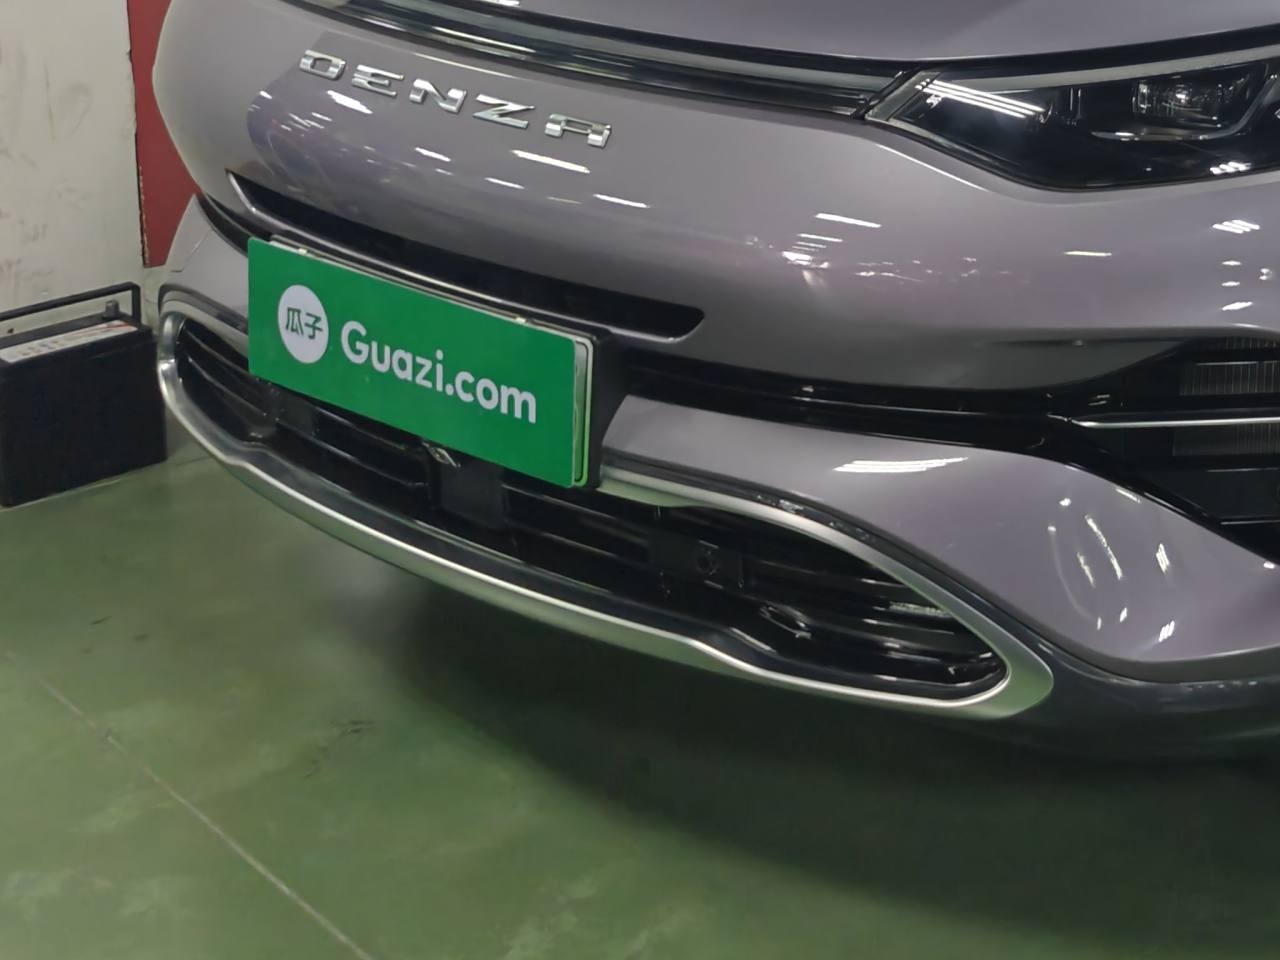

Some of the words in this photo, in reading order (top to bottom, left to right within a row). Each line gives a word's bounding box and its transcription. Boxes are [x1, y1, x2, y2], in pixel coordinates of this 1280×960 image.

[299, 49, 612, 148] DENZA
[285, 307, 324, 340] 瓜子
[341, 321, 537, 424] Guazi.com
